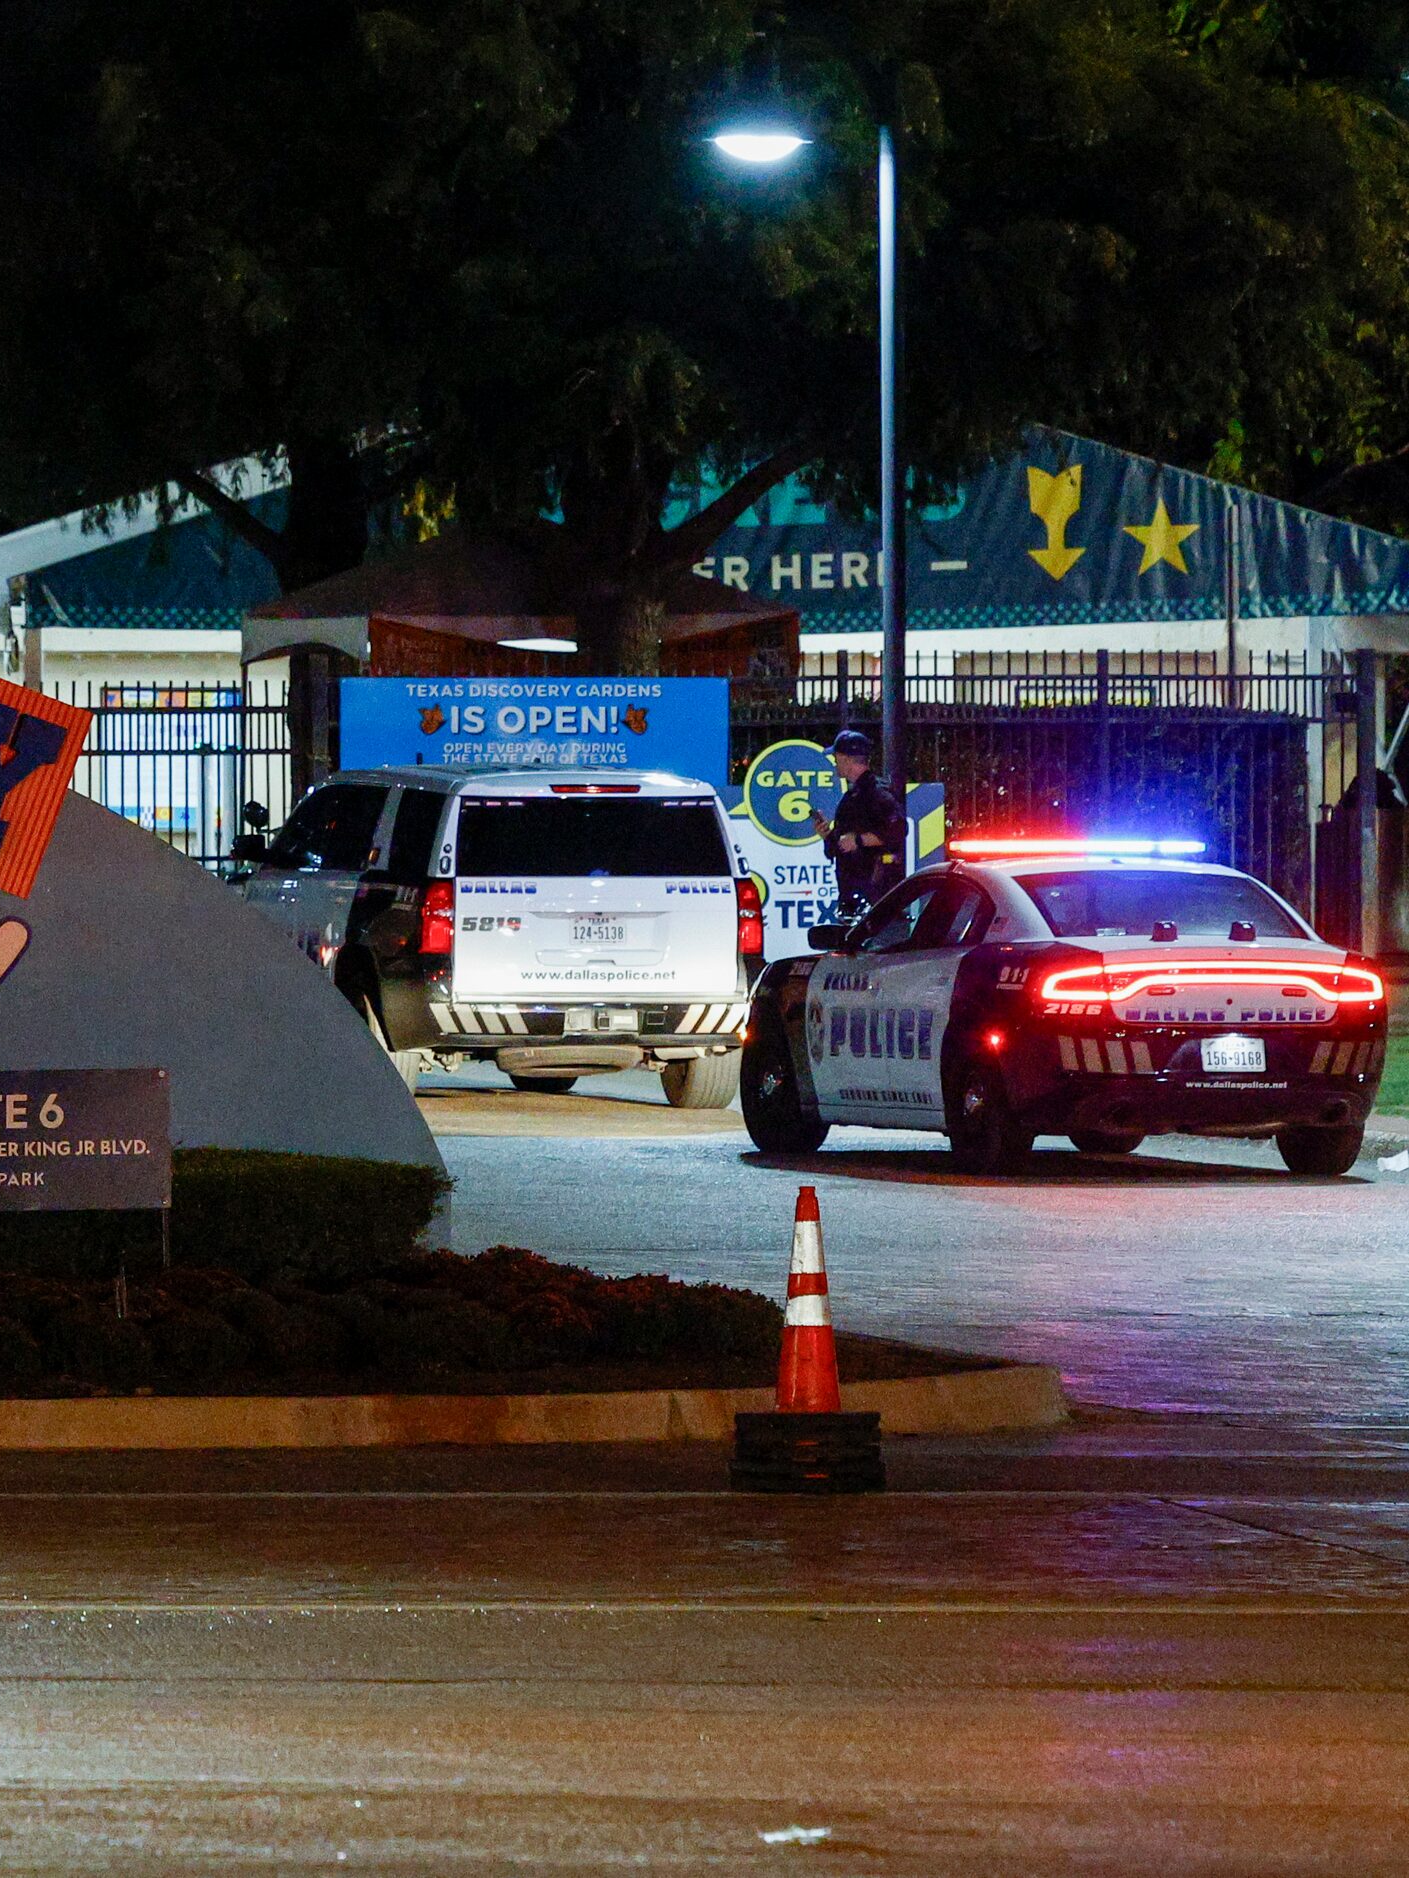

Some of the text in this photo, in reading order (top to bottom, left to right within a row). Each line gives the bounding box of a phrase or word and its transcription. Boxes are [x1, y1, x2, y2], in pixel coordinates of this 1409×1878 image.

[771, 550, 883, 591] HER
[406, 684, 662, 698] TEXAS DISCOVERY GARDENS
[450, 705, 619, 735] IS OPEN!
[443, 742, 626, 753] OPEN EVERY DAY DURING
[443, 753, 471, 764] THE
[474, 753, 518, 764] STATE
[559, 753, 577, 764] OF
[582, 753, 628, 765] TEXAS
[756, 771, 834, 787] GATE
[778, 790, 811, 823] 6
[774, 865, 833, 885] STATE
[460, 881, 538, 894] DALLAS
[665, 881, 732, 894] POLICE
[817, 886, 837, 897] OF
[774, 900, 839, 929] TEX
[573, 926, 625, 940] 124-5138
[521, 970, 676, 982] www.dallaspolice.net
[1043, 1003, 1103, 1015] 2186
[1125, 1007, 1326, 1021] DALLAS POLICE
[830, 1007, 933, 1059] POLICE
[1206, 1051, 1262, 1066] 156-9168
[1185, 1081, 1288, 1090] www.dallaspolice.net
[39, 1093, 65, 1129] 6
[24, 1140, 71, 1157] KING
[75, 1140, 95, 1157] JR
[100, 1139, 151, 1156] BLVD.
